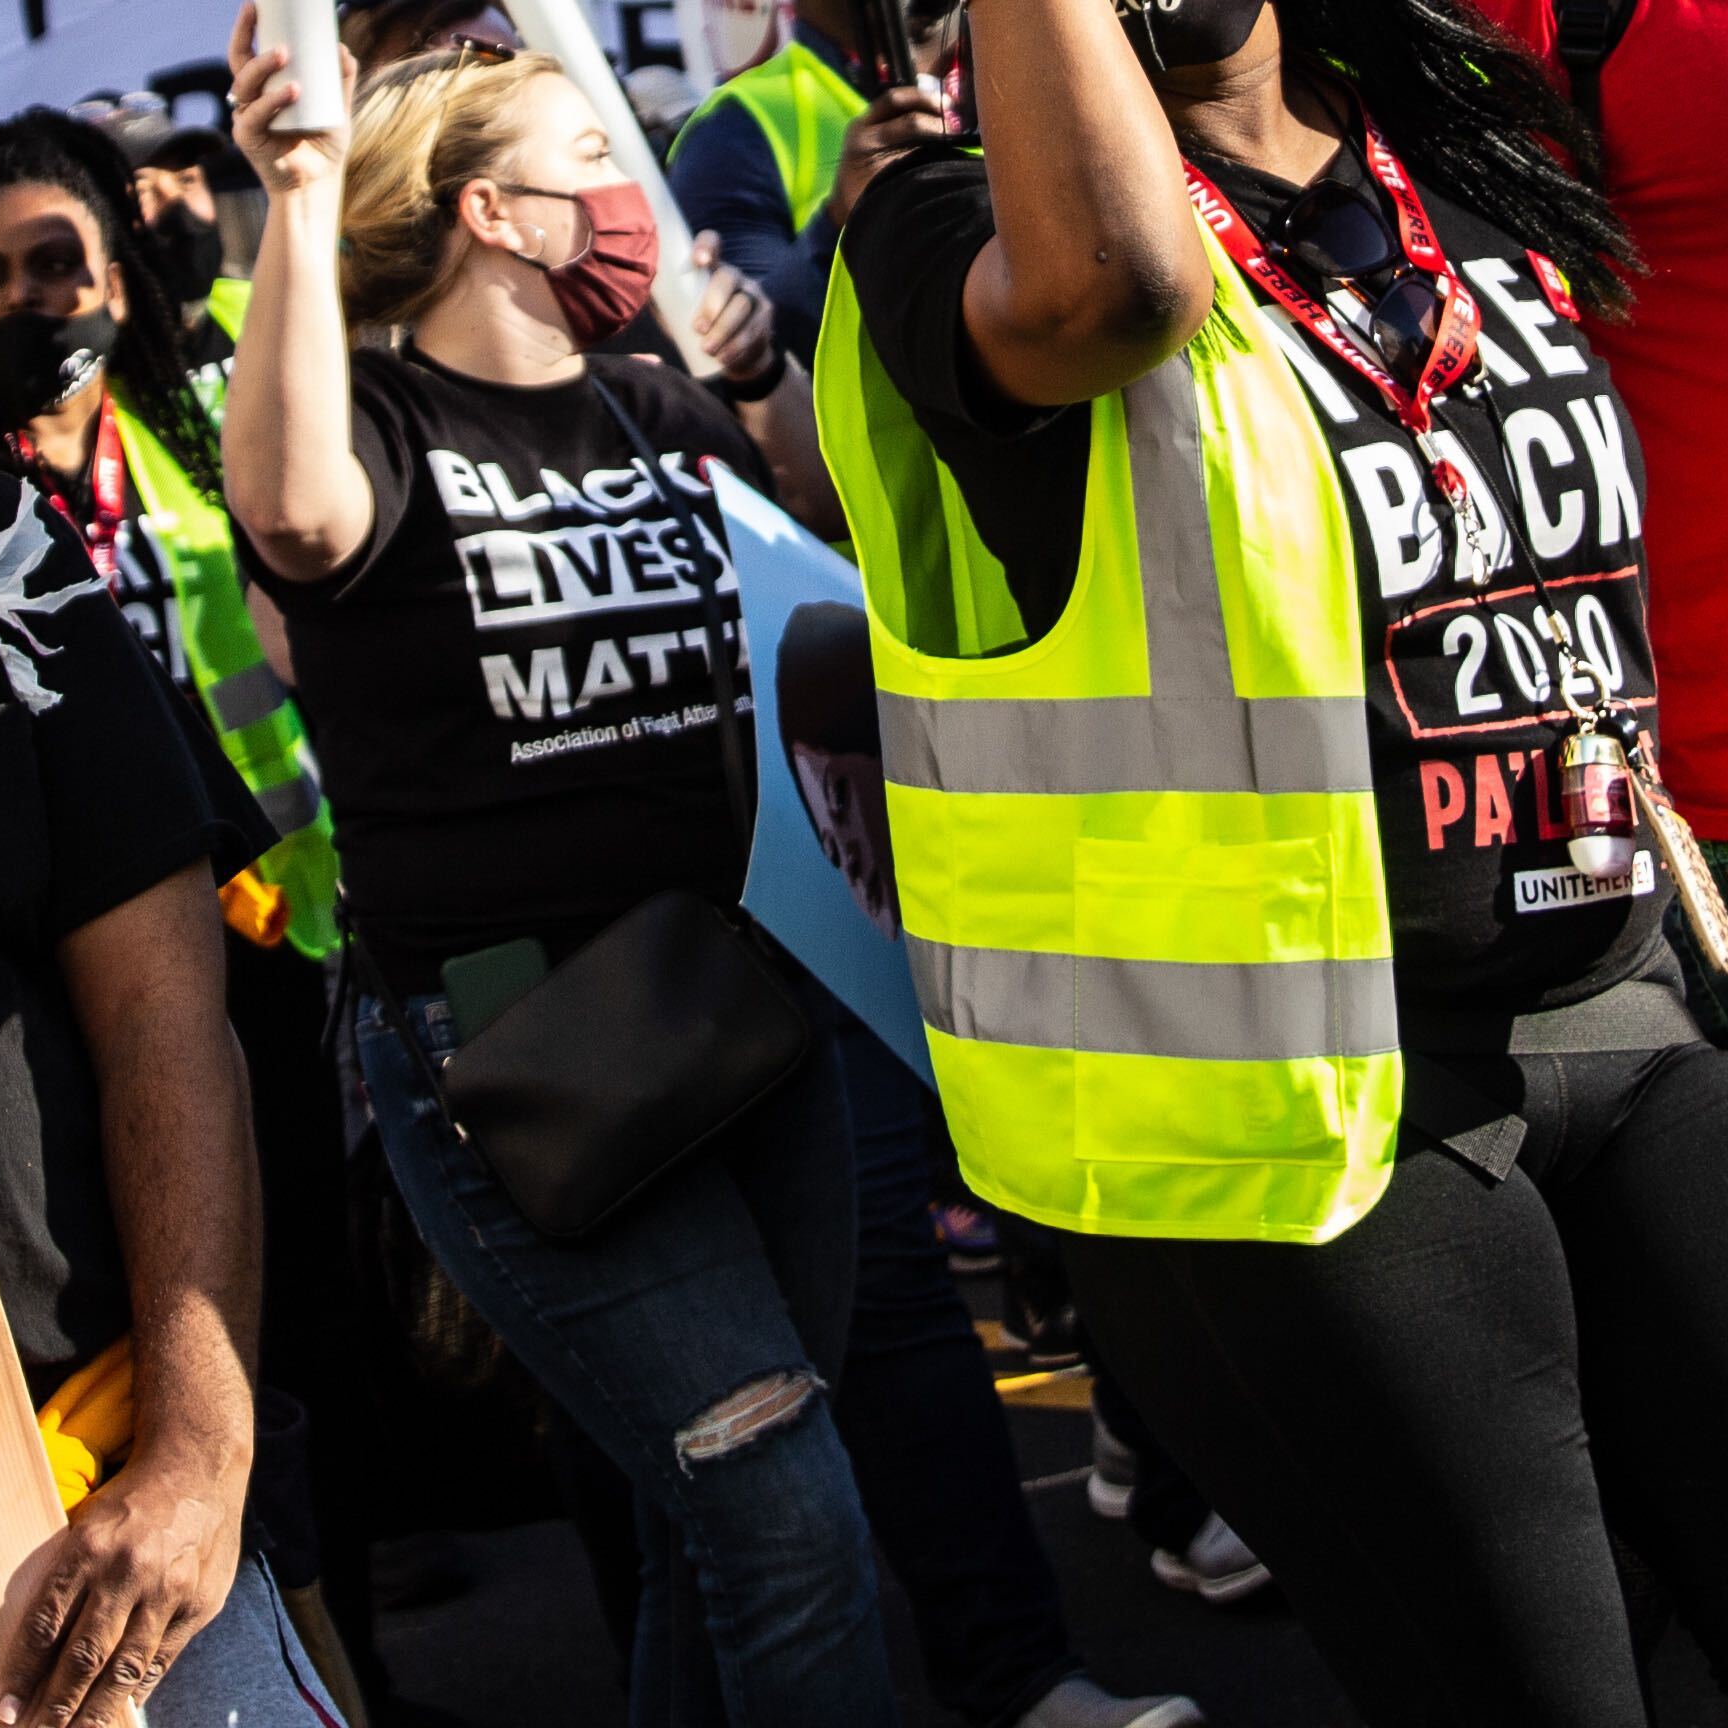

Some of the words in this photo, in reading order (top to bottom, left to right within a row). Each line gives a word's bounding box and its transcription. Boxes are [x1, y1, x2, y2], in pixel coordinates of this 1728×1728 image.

[426, 449, 715, 521] BLACK
[1341, 396, 1643, 599] BACK
[468, 525, 720, 613] LIVES
[479, 619, 751, 720] MATT
[511, 725, 618, 764] Association
[622, 715, 645, 738] of
